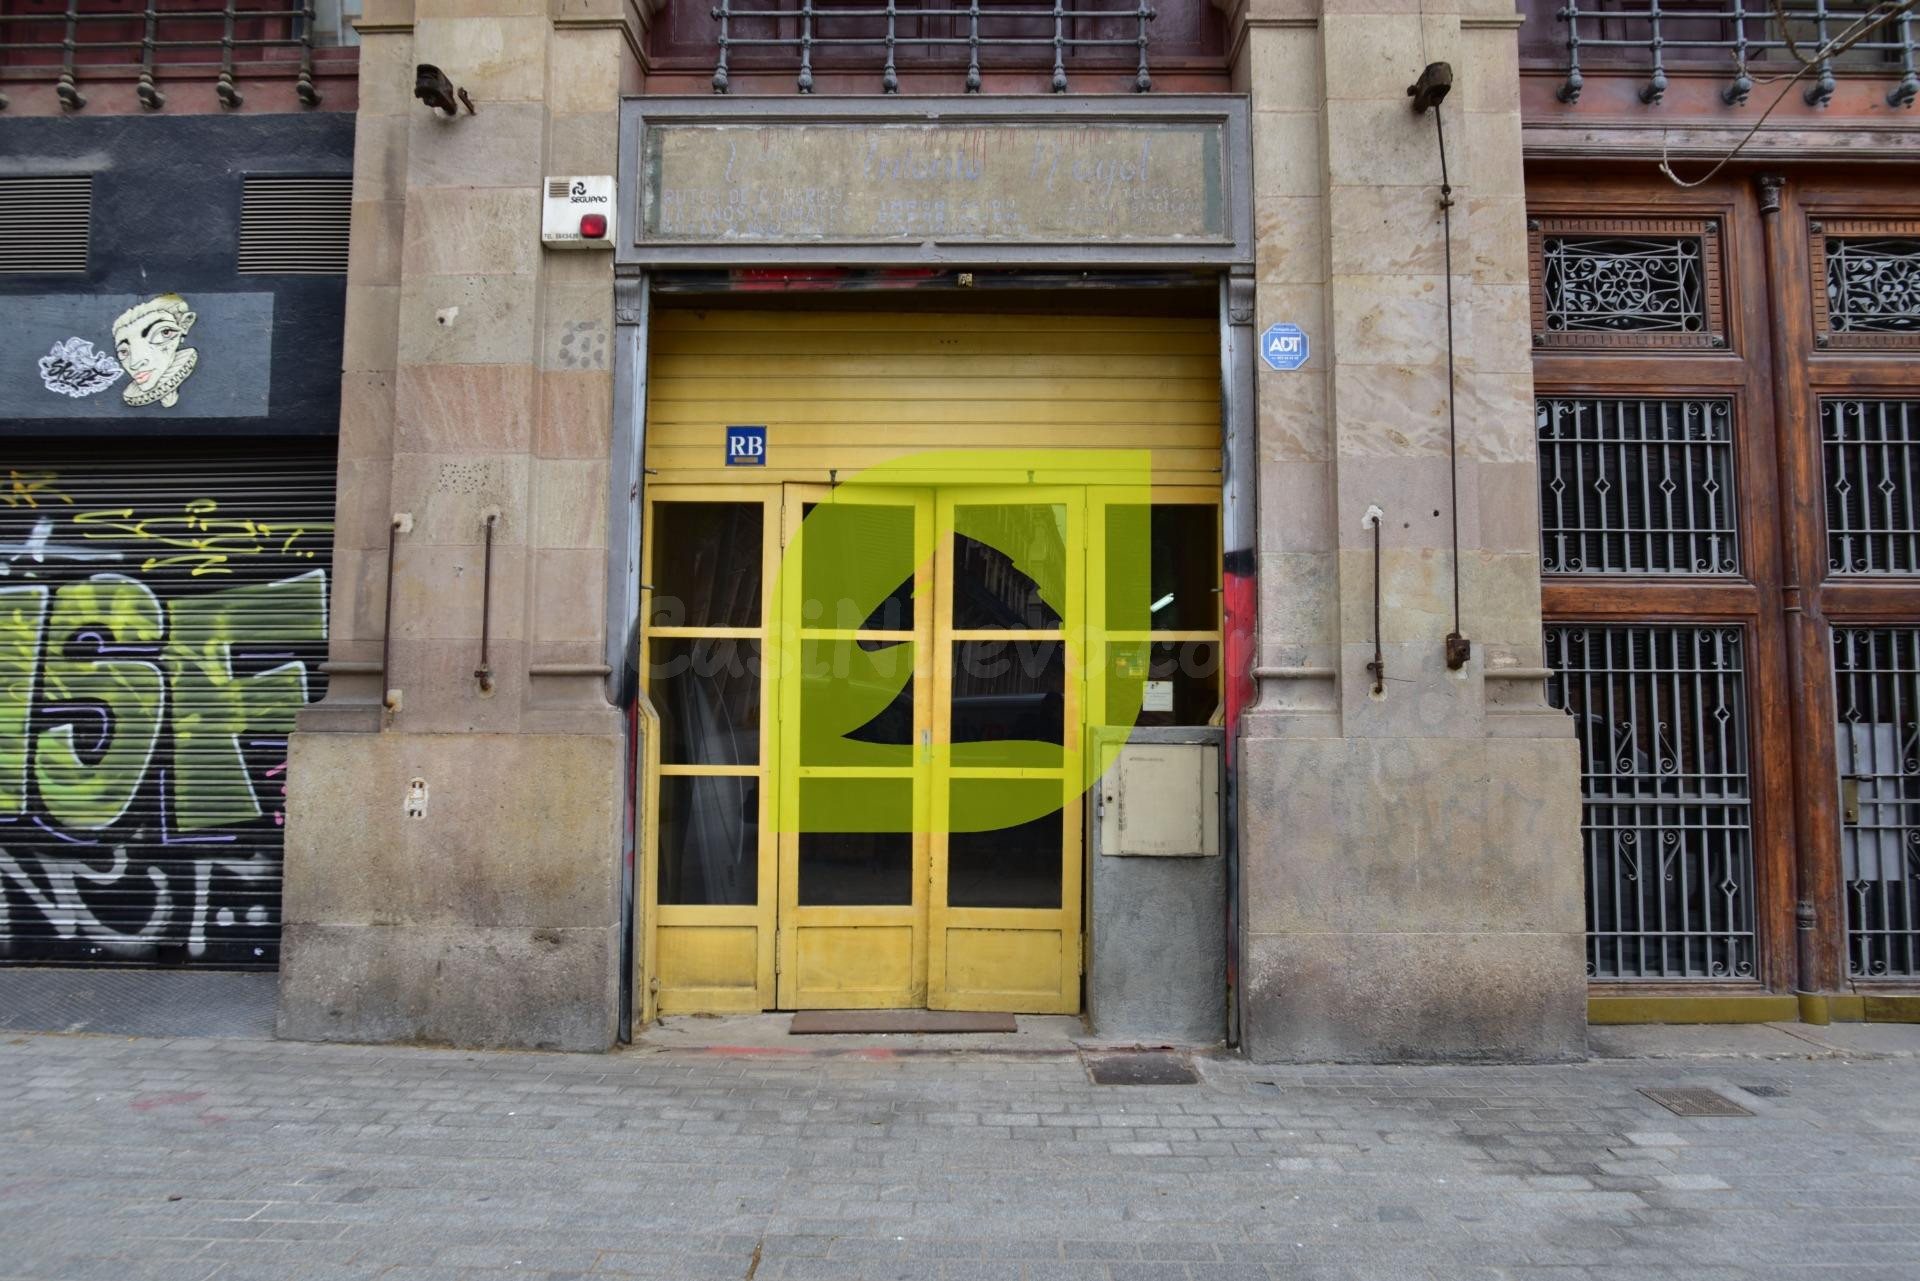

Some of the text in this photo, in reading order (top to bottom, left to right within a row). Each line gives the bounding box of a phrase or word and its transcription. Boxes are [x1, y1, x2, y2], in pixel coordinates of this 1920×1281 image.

[879, 200, 1016, 210] IMPORACION
[878, 212, 1018, 223] EXPORACION
[1270, 336, 1301, 352] ADT
[729, 435, 764, 457] RB
